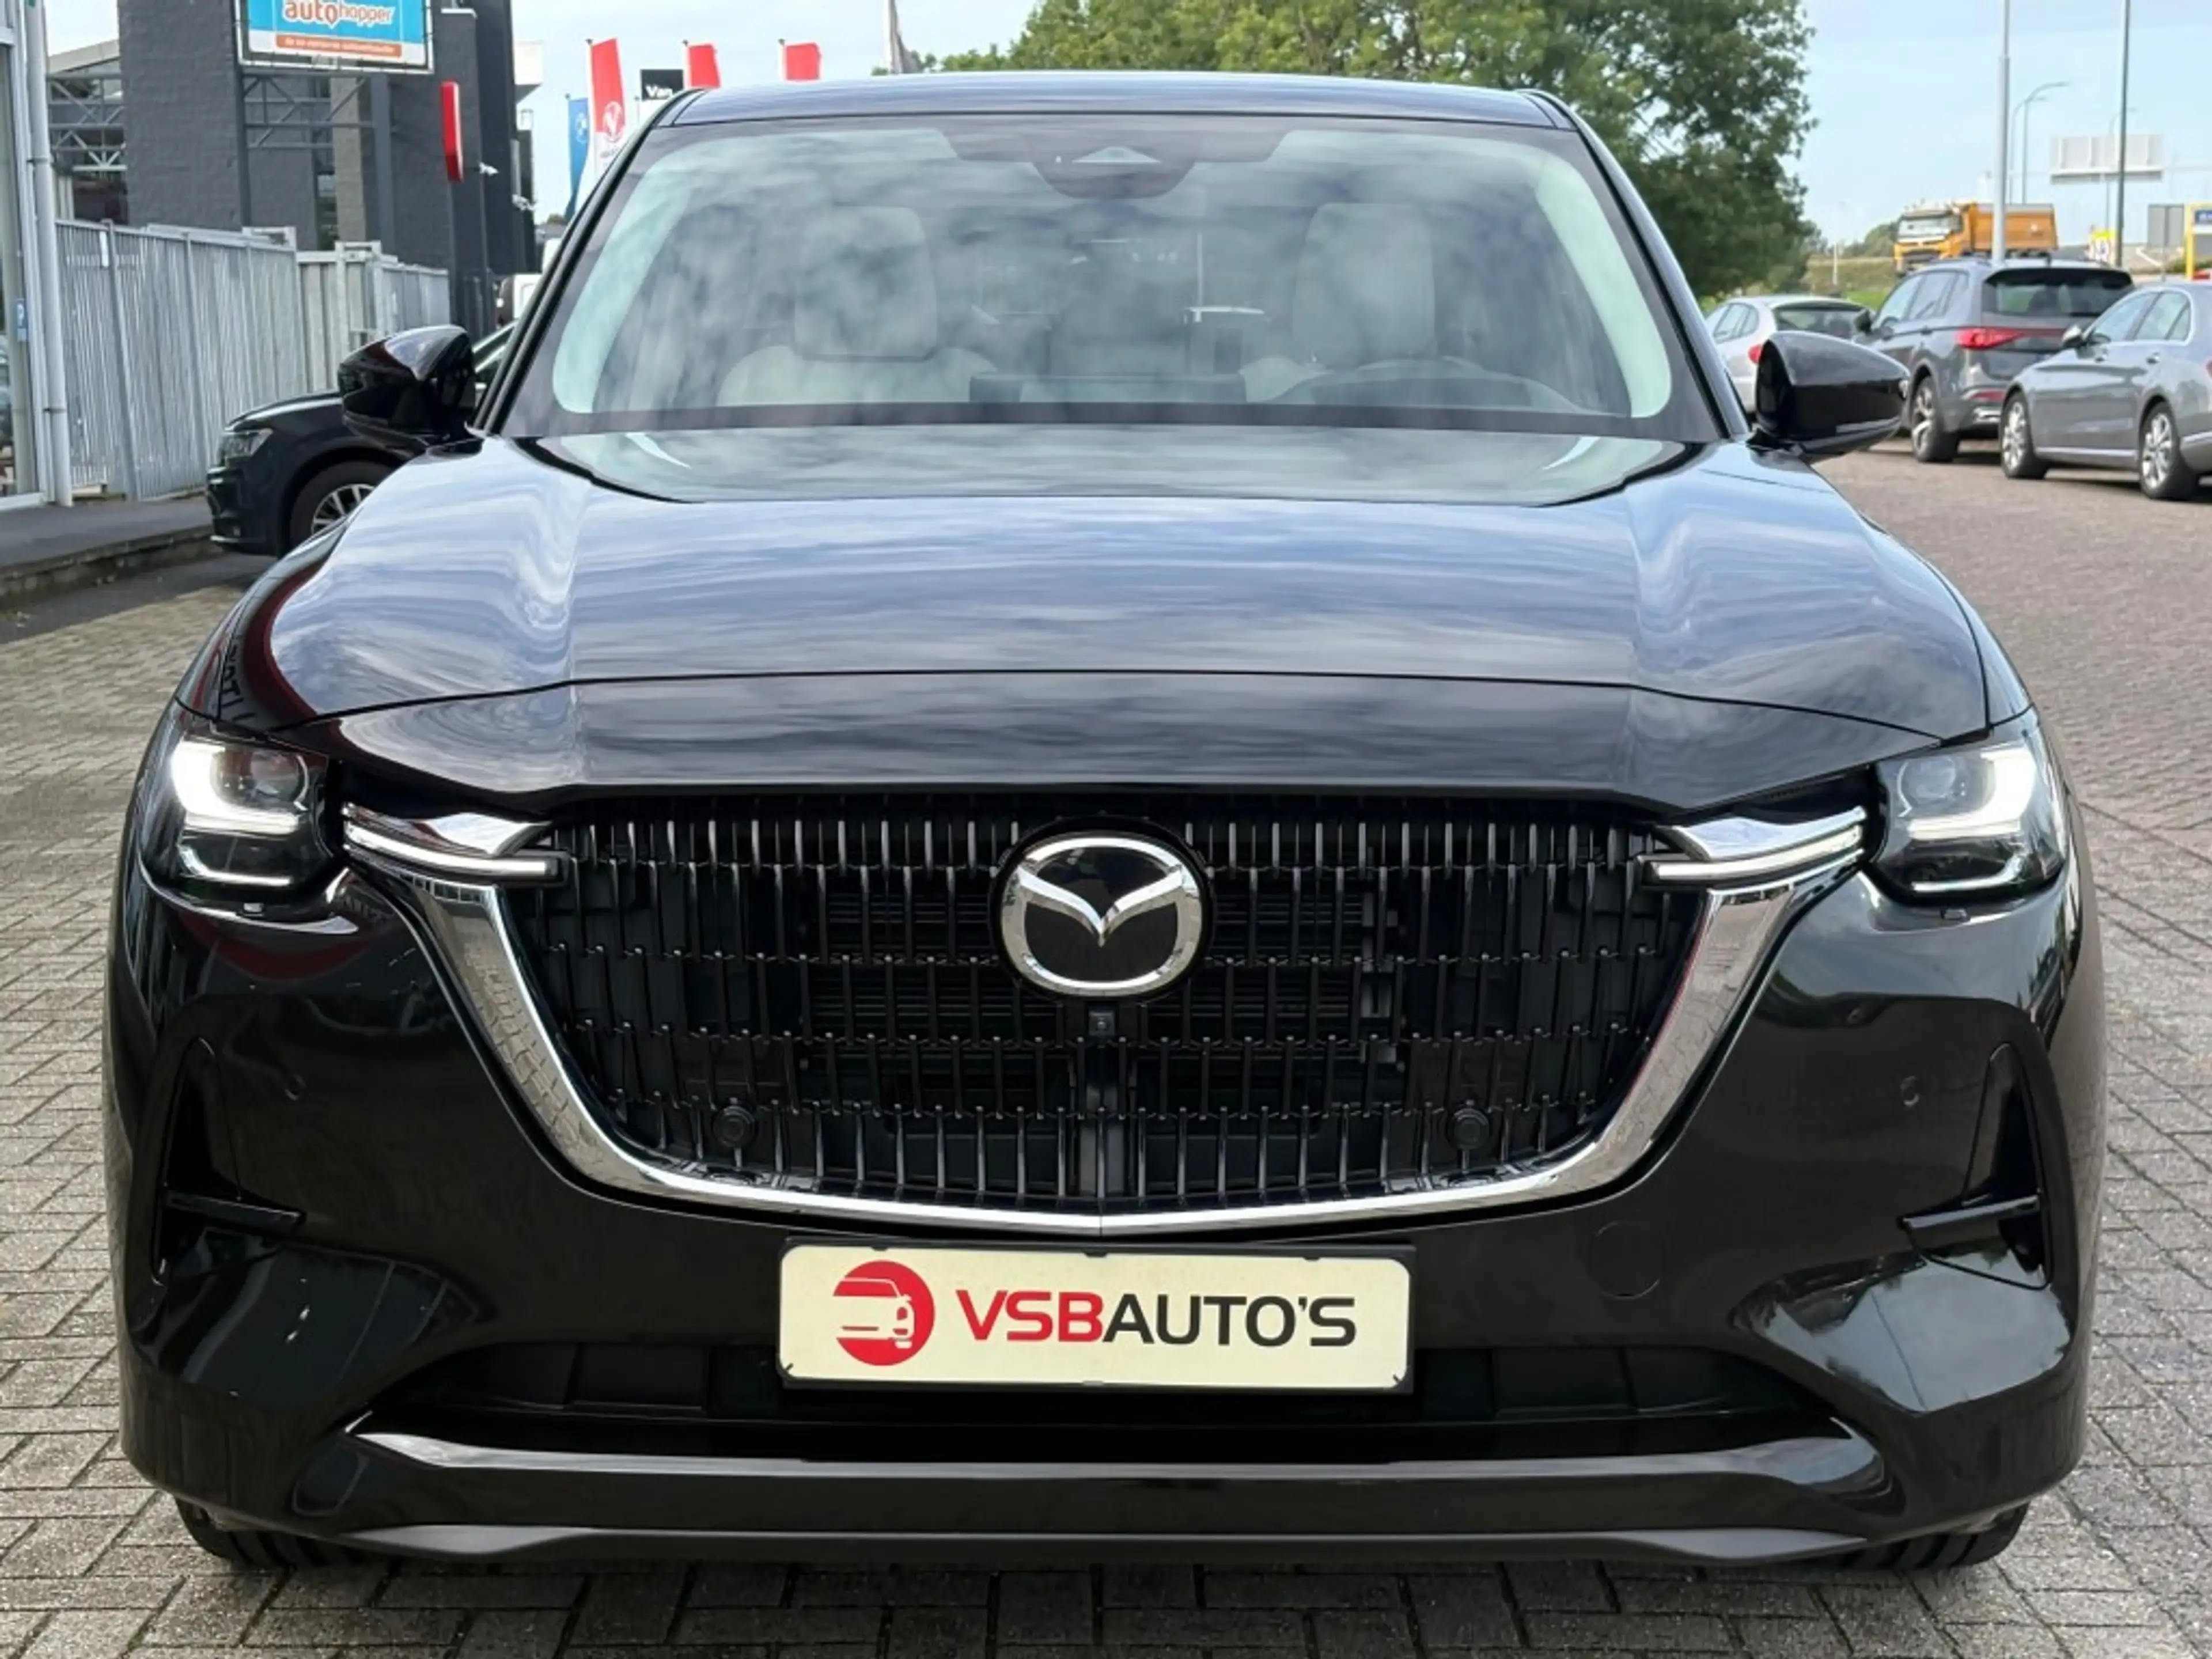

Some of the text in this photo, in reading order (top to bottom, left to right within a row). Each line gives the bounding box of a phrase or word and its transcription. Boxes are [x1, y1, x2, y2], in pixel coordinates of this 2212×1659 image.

[286, 0, 391, 24] autohopper
[646, 86, 673, 99] Van
[956, 1289, 1356, 1347] VSBAUTO'S
